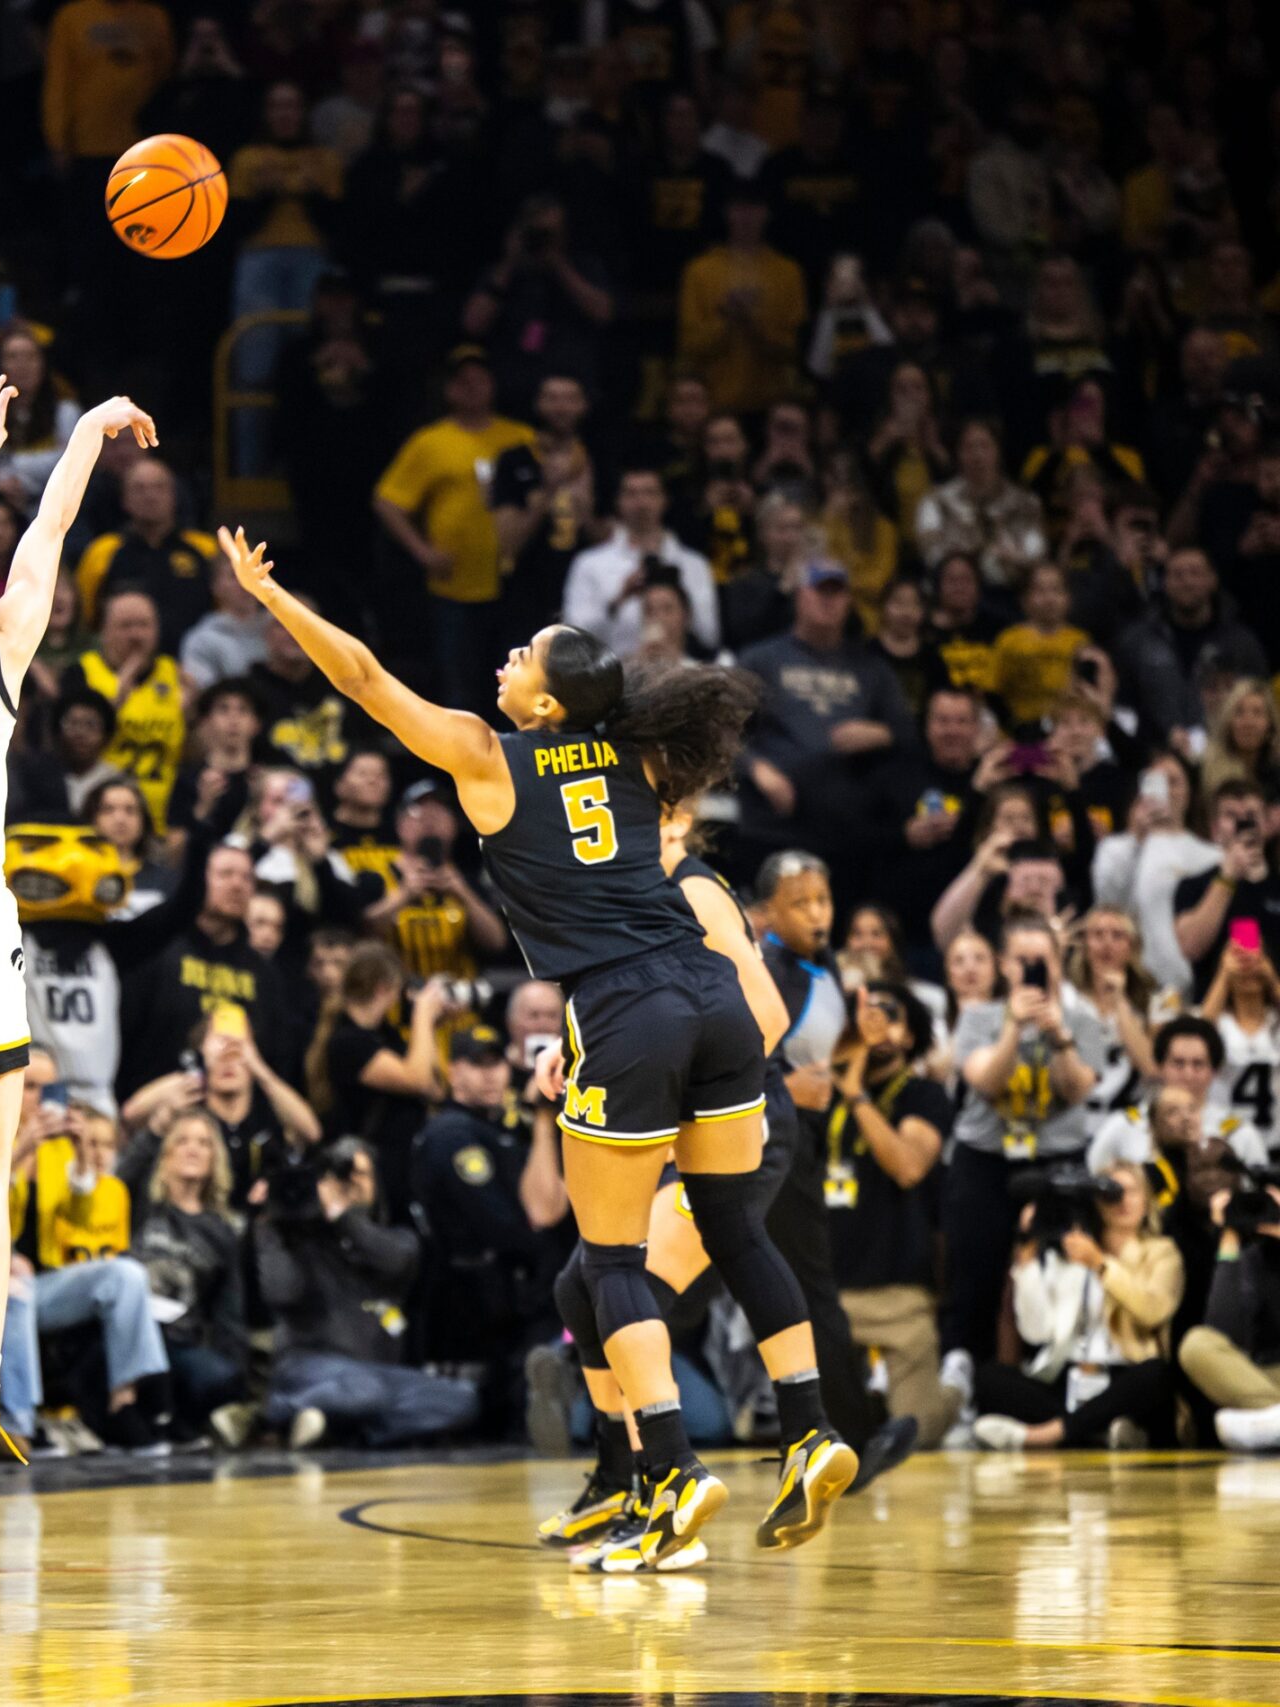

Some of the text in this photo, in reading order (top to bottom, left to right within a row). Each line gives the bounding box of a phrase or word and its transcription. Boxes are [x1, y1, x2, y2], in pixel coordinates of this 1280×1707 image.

[534, 741, 619, 777] PHELIA
[560, 775, 619, 865] 5
[564, 1083, 608, 1127] M
